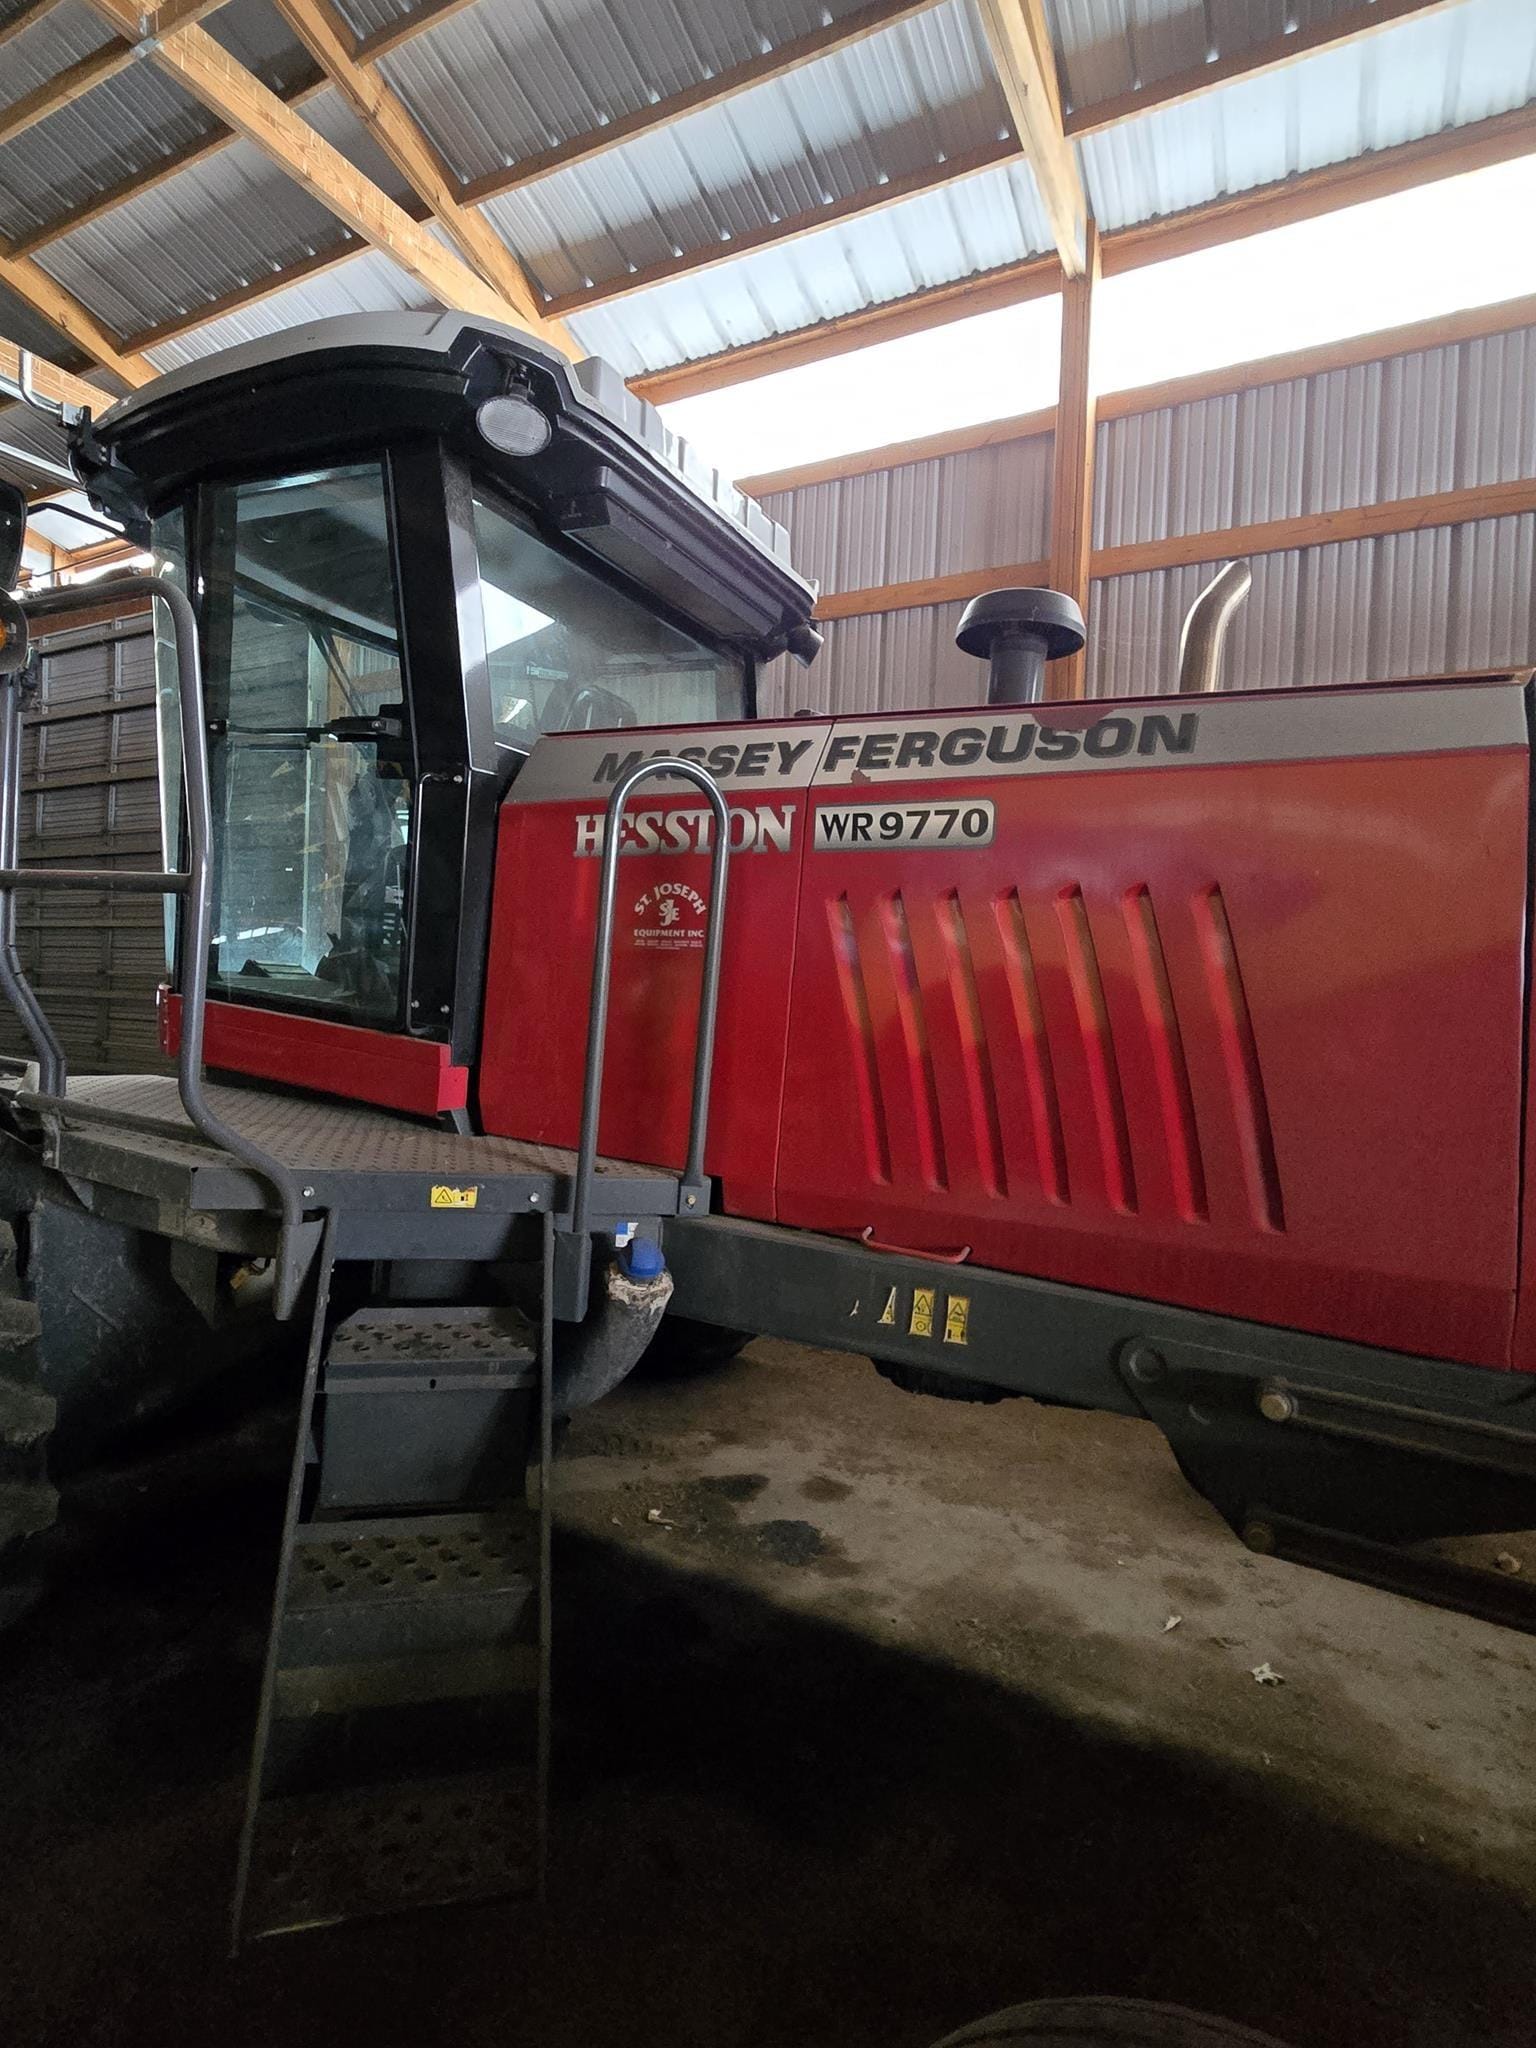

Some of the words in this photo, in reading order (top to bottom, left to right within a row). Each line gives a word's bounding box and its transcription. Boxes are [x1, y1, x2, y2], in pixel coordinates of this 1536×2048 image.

[822, 712, 1199, 772] FERGUSON
[820, 808, 990, 842] WR9770
[634, 894, 652, 916] ST.
[653, 883, 707, 915] JOSEPH
[633, 929, 685, 938] EQUIPMENT
[687, 929, 705, 938] INC
